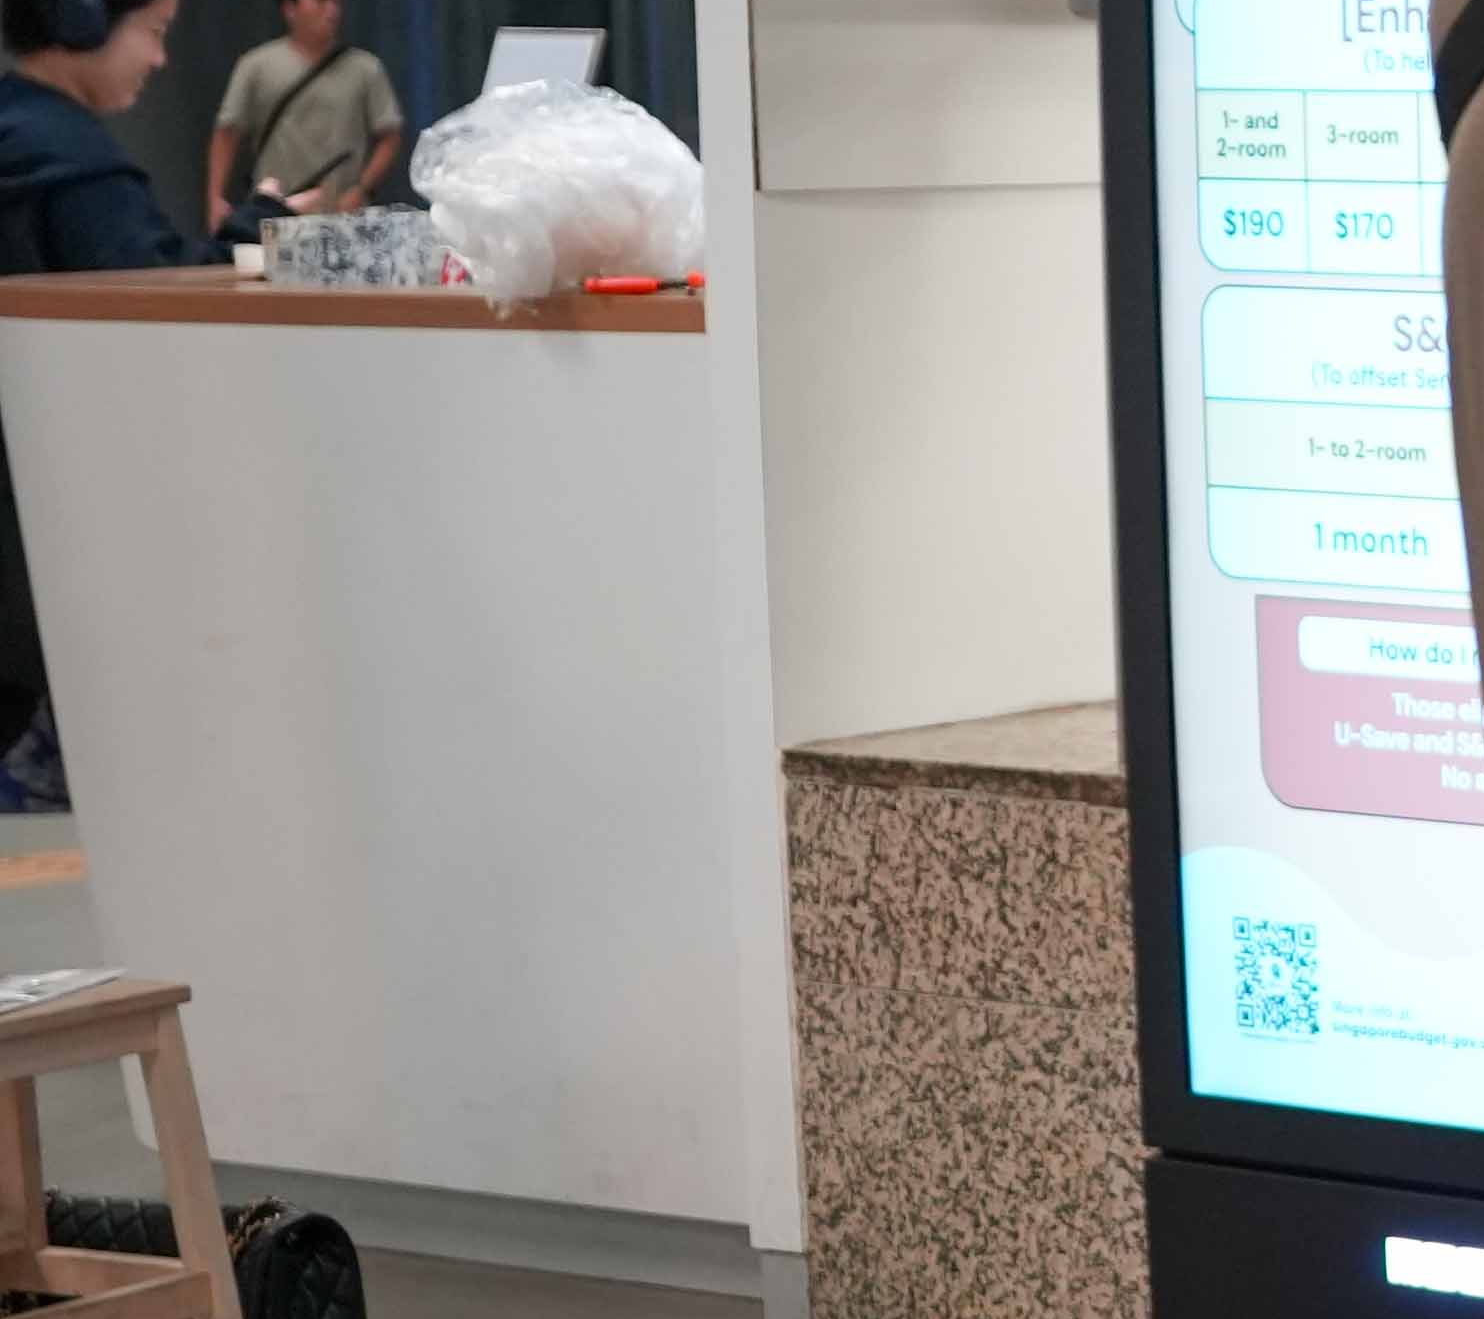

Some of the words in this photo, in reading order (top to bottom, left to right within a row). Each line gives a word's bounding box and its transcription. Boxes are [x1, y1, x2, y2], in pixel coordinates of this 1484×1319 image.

[1245, 112, 1279, 130] and
[1326, 124, 1400, 145] 3-room
[1216, 137, 1287, 159] 2-room
[1223, 209, 1284, 237] $190
[1335, 212, 1394, 239] $170
[1349, 363, 1407, 388] offset
[1331, 441, 1350, 458] to
[1355, 440, 1428, 461] 2-room
[1314, 521, 1325, 552] 1
[1332, 527, 1430, 557] month
[1368, 639, 1418, 662] How
[1425, 642, 1453, 665] do
[1391, 691, 1457, 721] Those
[1333, 719, 1411, 752] U-Save
[1413, 730, 1455, 754] and
[1440, 763, 1473, 791] No
